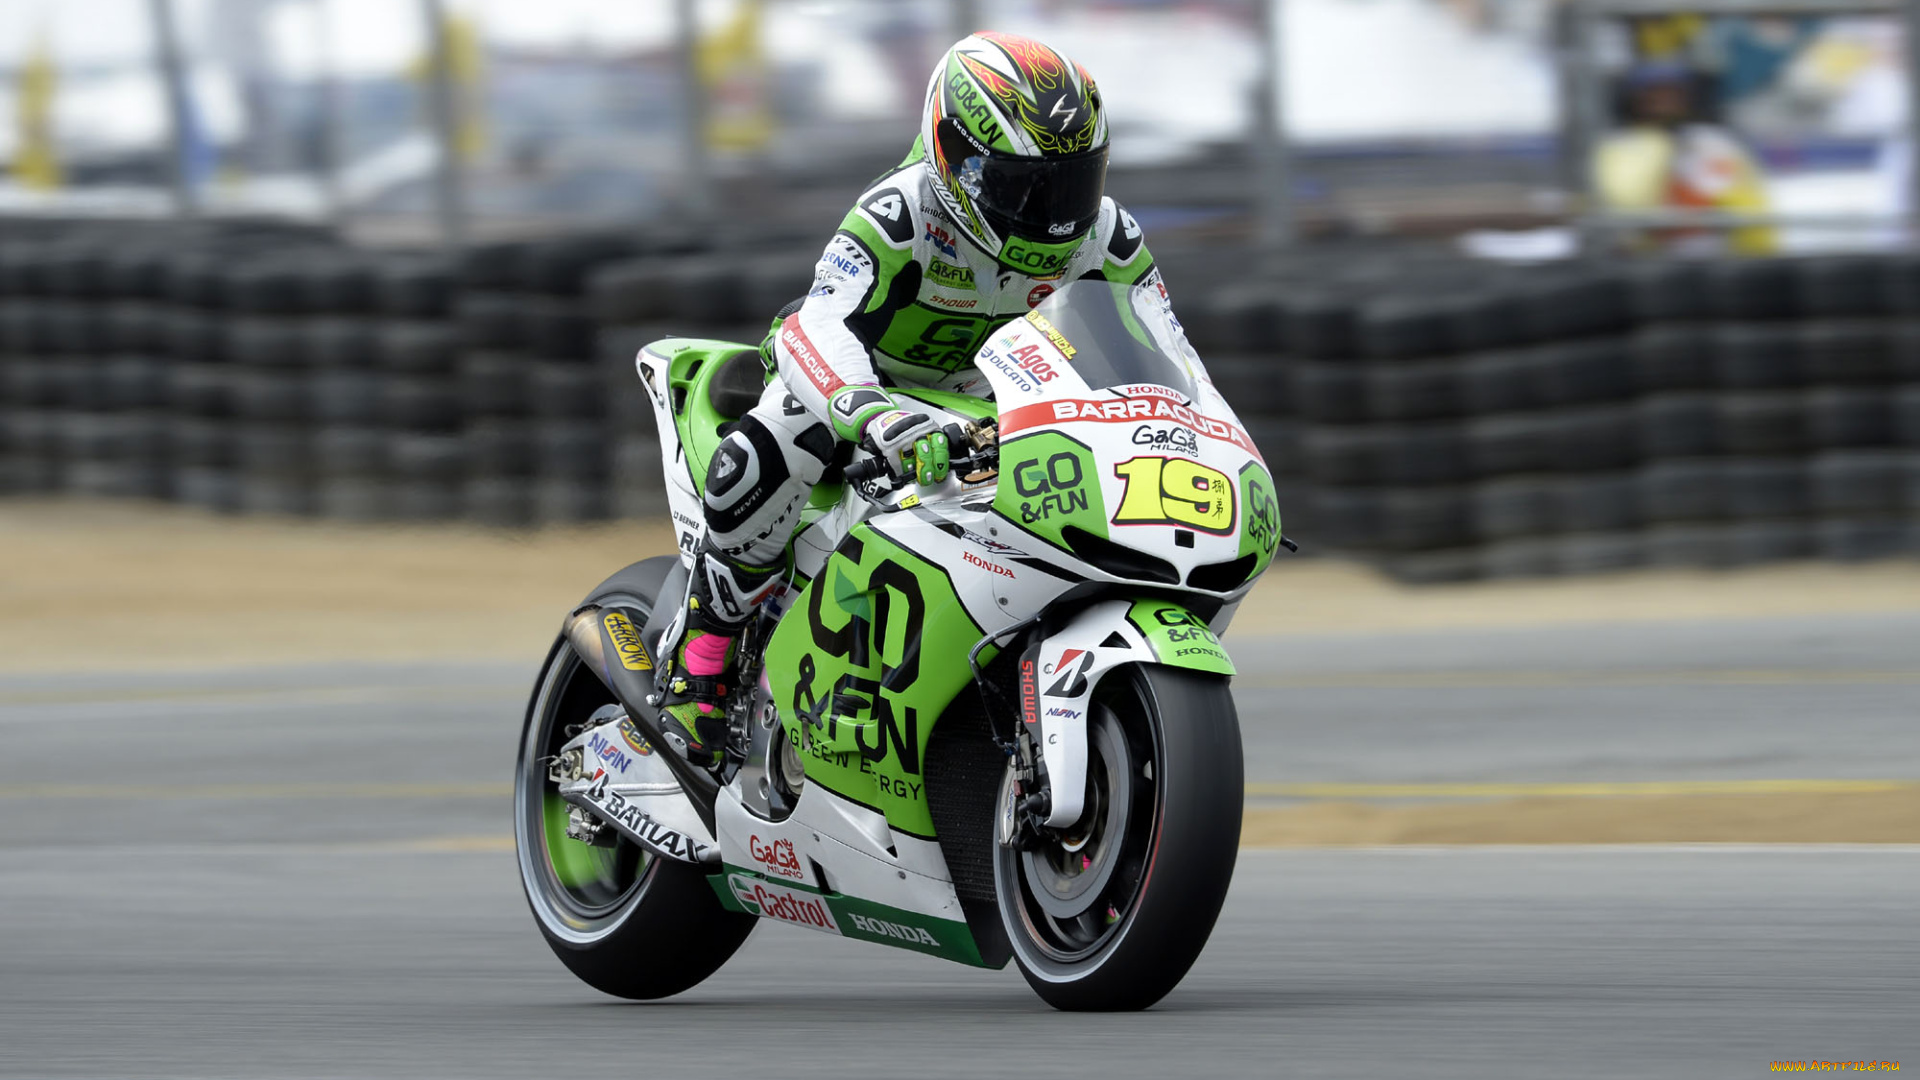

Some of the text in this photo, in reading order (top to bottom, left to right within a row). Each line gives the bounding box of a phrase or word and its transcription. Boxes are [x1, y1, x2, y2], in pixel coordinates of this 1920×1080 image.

[949, 71, 1004, 146] GO&FUN
[929, 295, 978, 309] SHOWA
[782, 328, 831, 389] BARRACUDA
[990, 355, 1031, 392] DUCATO
[1012, 344, 1059, 383] Agos
[1127, 387, 1183, 401] HONDA
[1052, 400, 1248, 448] BARRACUDA
[1013, 451, 1083, 497] GO
[1150, 444, 1199, 458] MILANO
[1021, 488, 1089, 524] &FUN
[1111, 455, 1237, 537] 19
[963, 551, 1017, 579] HONDA
[808, 534, 926, 694] GO
[607, 616, 651, 667] ARROW
[793, 653, 921, 776] &FUN
[1022, 660, 1037, 723] SHOWA
[860, 754, 922, 801] ERGY
[767, 864, 804, 879] MILANO
[754, 885, 941, 947] Castrol HONDA
